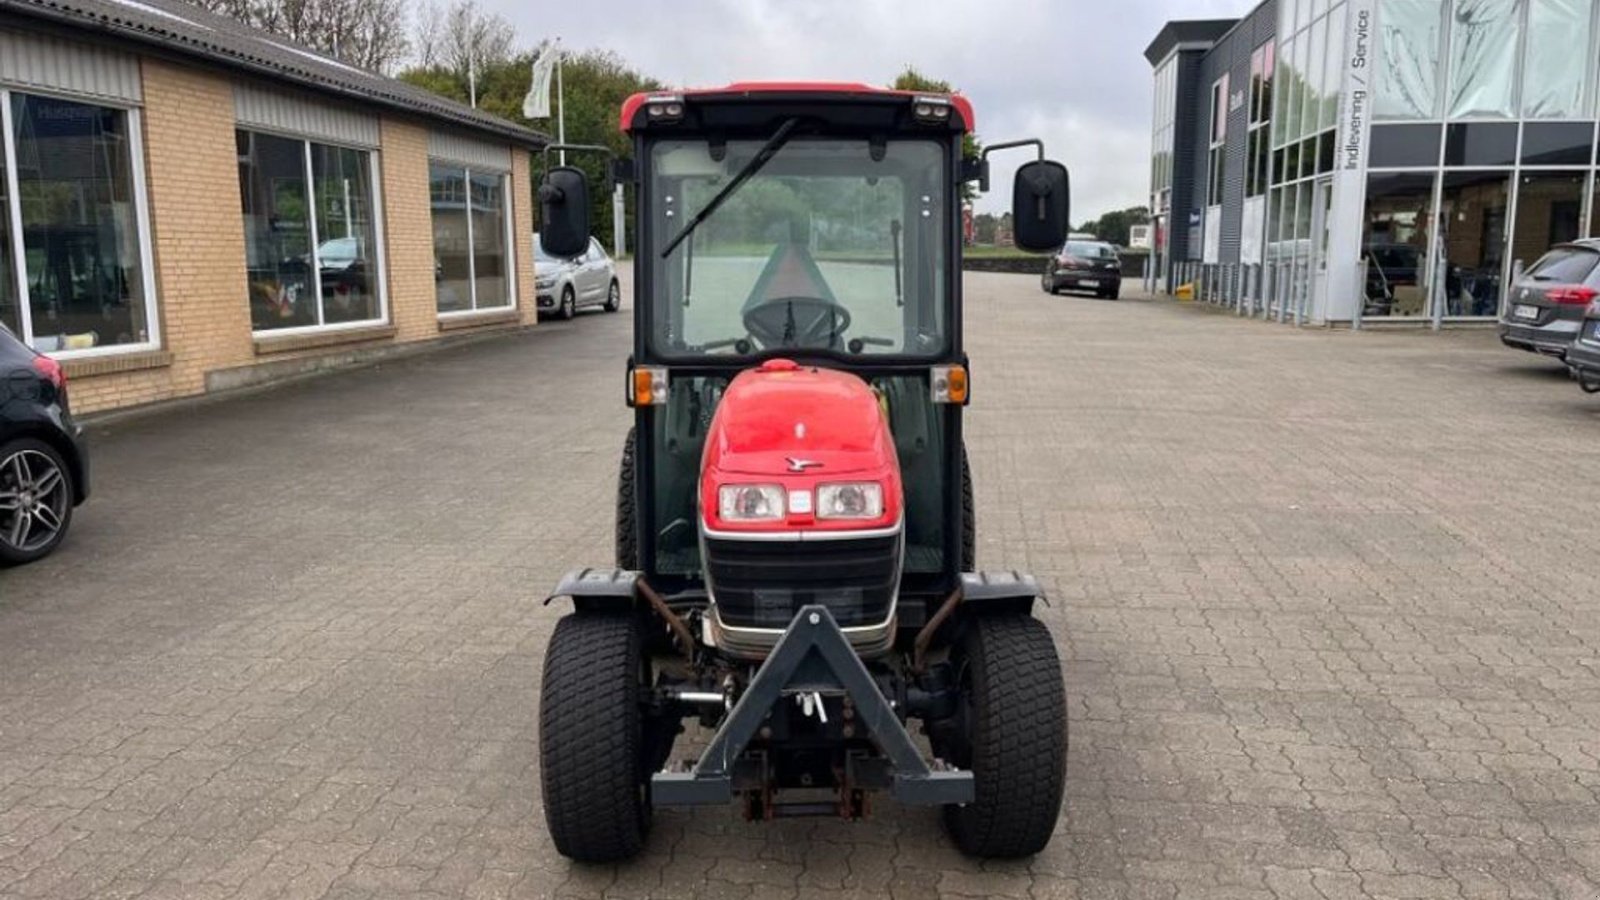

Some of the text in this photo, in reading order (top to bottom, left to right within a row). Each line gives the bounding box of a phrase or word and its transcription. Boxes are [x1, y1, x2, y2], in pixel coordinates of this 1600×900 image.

[1344, 10, 1369, 170] Indlevering / Service
